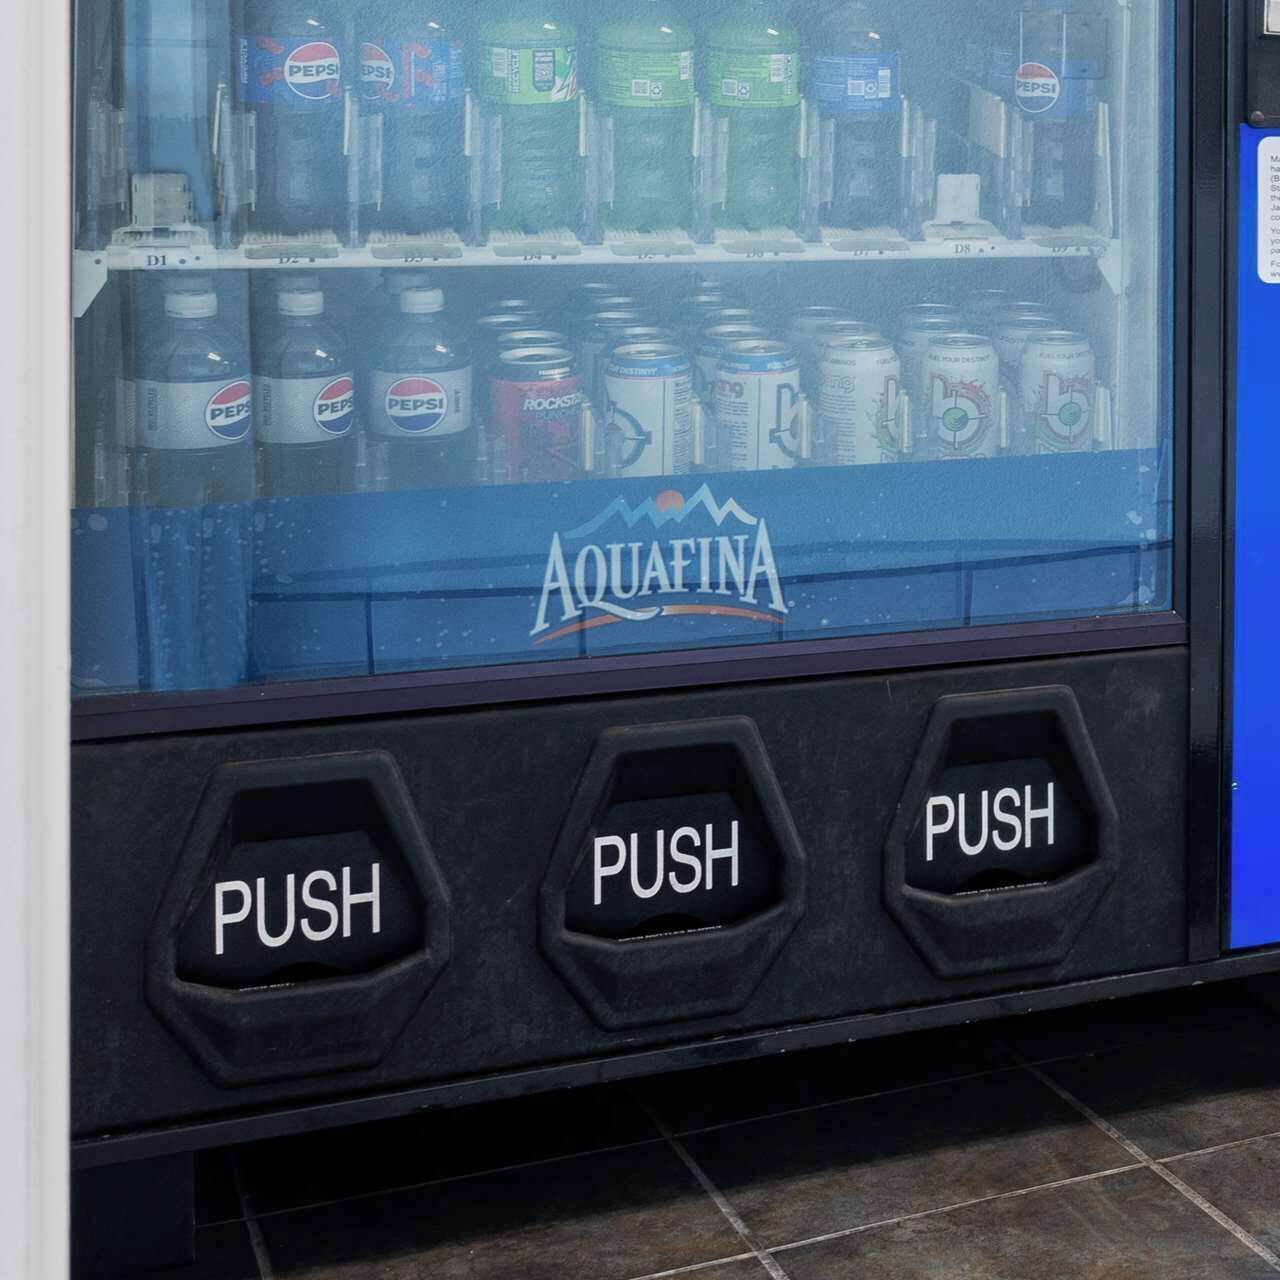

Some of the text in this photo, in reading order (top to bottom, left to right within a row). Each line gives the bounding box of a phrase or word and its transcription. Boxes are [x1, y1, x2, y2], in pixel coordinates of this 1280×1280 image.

[1016, 80, 1057, 94] PEPSI
[147, 255, 167, 267] D1
[955, 244, 971, 255] D8
[388, 398, 444, 412] PEPSI
[529, 517, 790, 637] AQUAFINA
[924, 783, 1056, 864] PUSH
[592, 820, 740, 907] PUSH
[213, 865, 382, 957] PUSH
